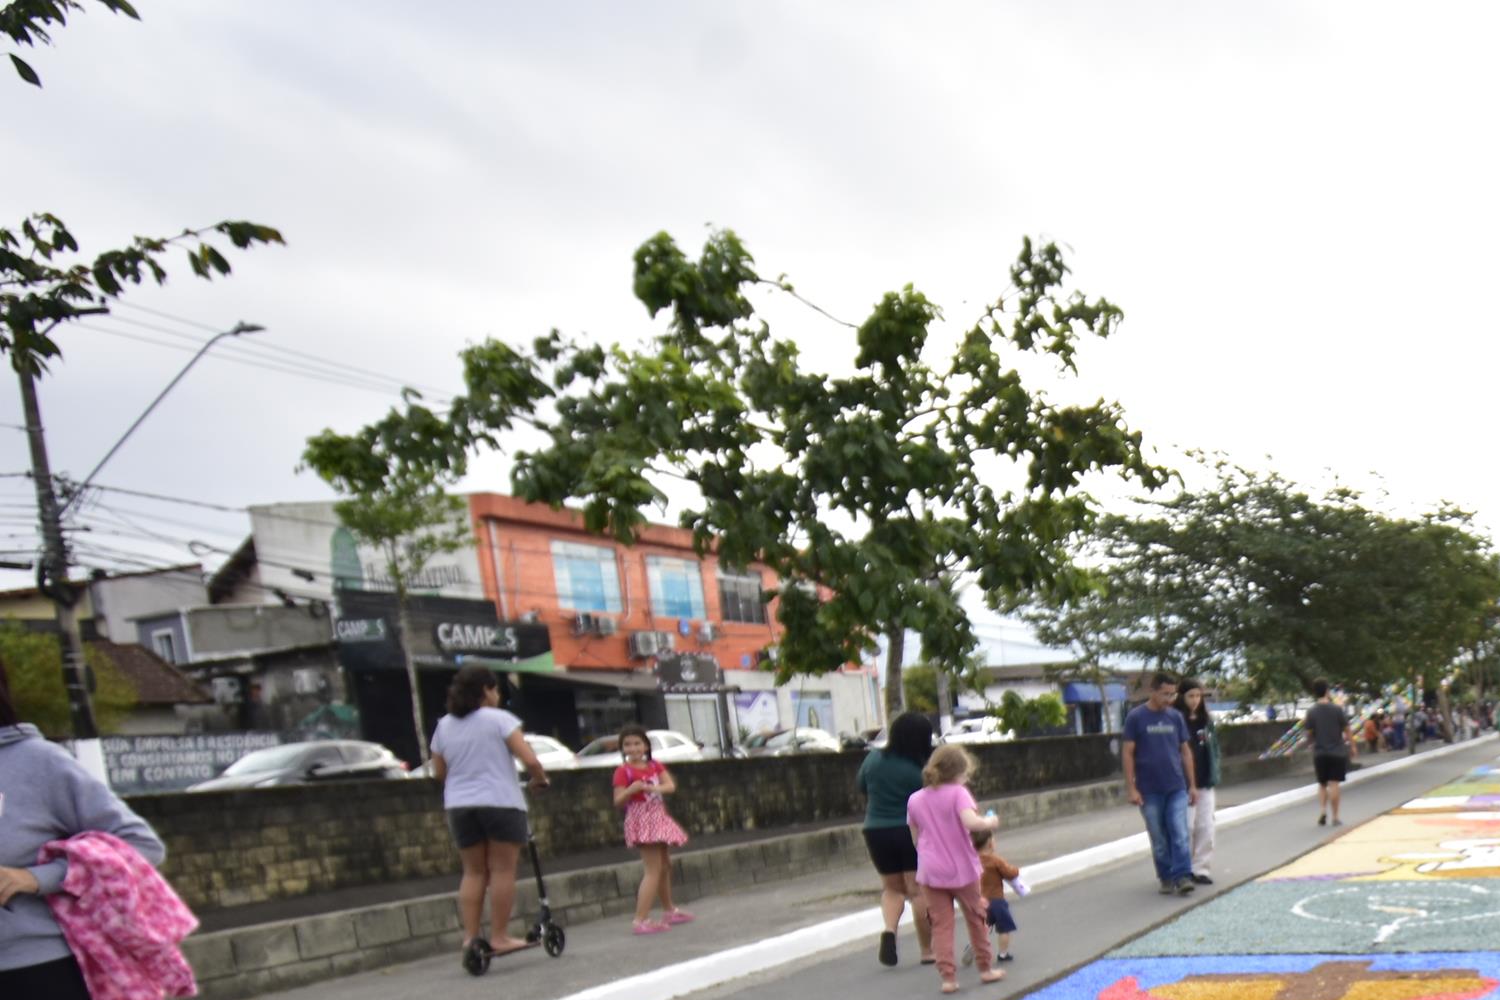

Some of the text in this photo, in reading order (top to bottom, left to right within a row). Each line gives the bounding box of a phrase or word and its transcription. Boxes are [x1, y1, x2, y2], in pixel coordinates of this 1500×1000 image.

[103, 738, 130, 751] SUA
[134, 736, 193, 750] EMPRESA
[111, 766, 210, 784] EM CONTATO
